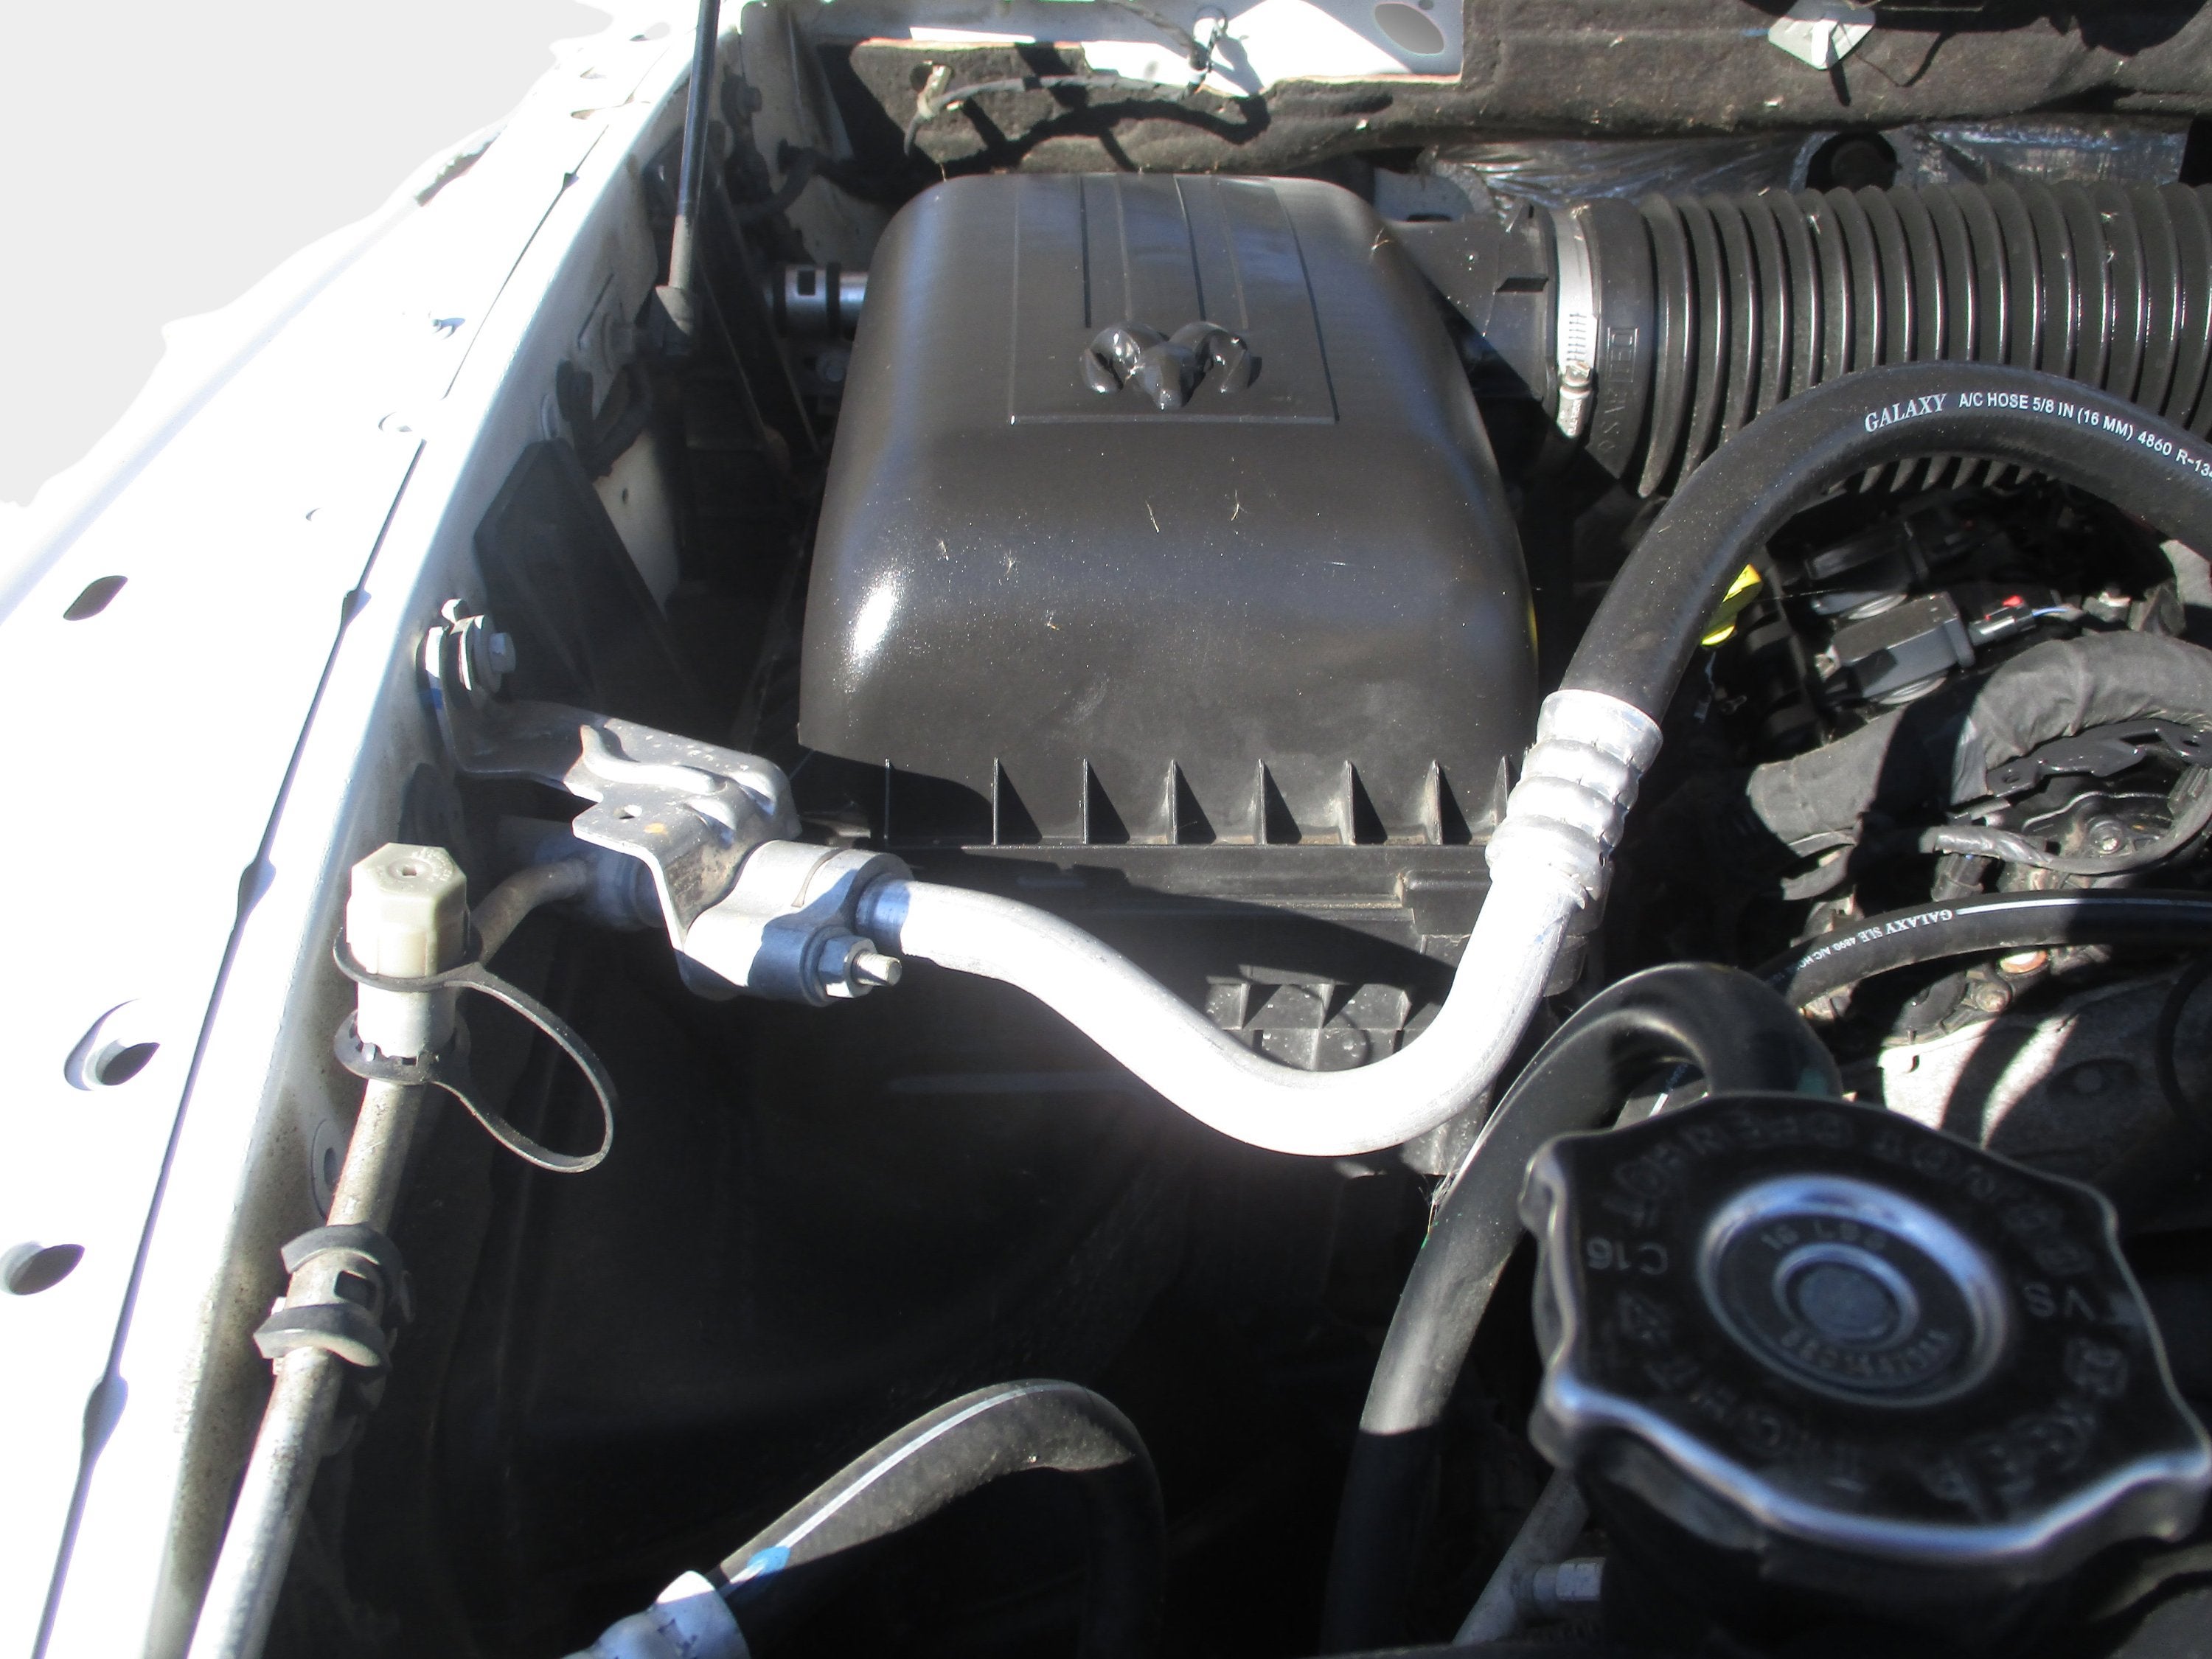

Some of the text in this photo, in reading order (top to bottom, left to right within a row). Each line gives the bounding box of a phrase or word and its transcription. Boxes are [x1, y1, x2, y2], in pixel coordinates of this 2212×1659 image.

[1864, 392, 1949, 433] GALAXY
[1958, 392, 1983, 409] A/C
[1987, 392, 2029, 411] HOSE
[2033, 396, 2054, 414] 5/8
[2058, 402, 2074, 420] IN
[2077, 406, 2100, 428] (16
[2102, 414, 2134, 442] MM)
[2137, 431, 2173, 457] 4860
[1857, 926, 1883, 944] SLE
[1885, 908, 1953, 935] GALAXY
[1587, 1236, 1668, 1276] C16
[2023, 1281, 2096, 1322] VS
